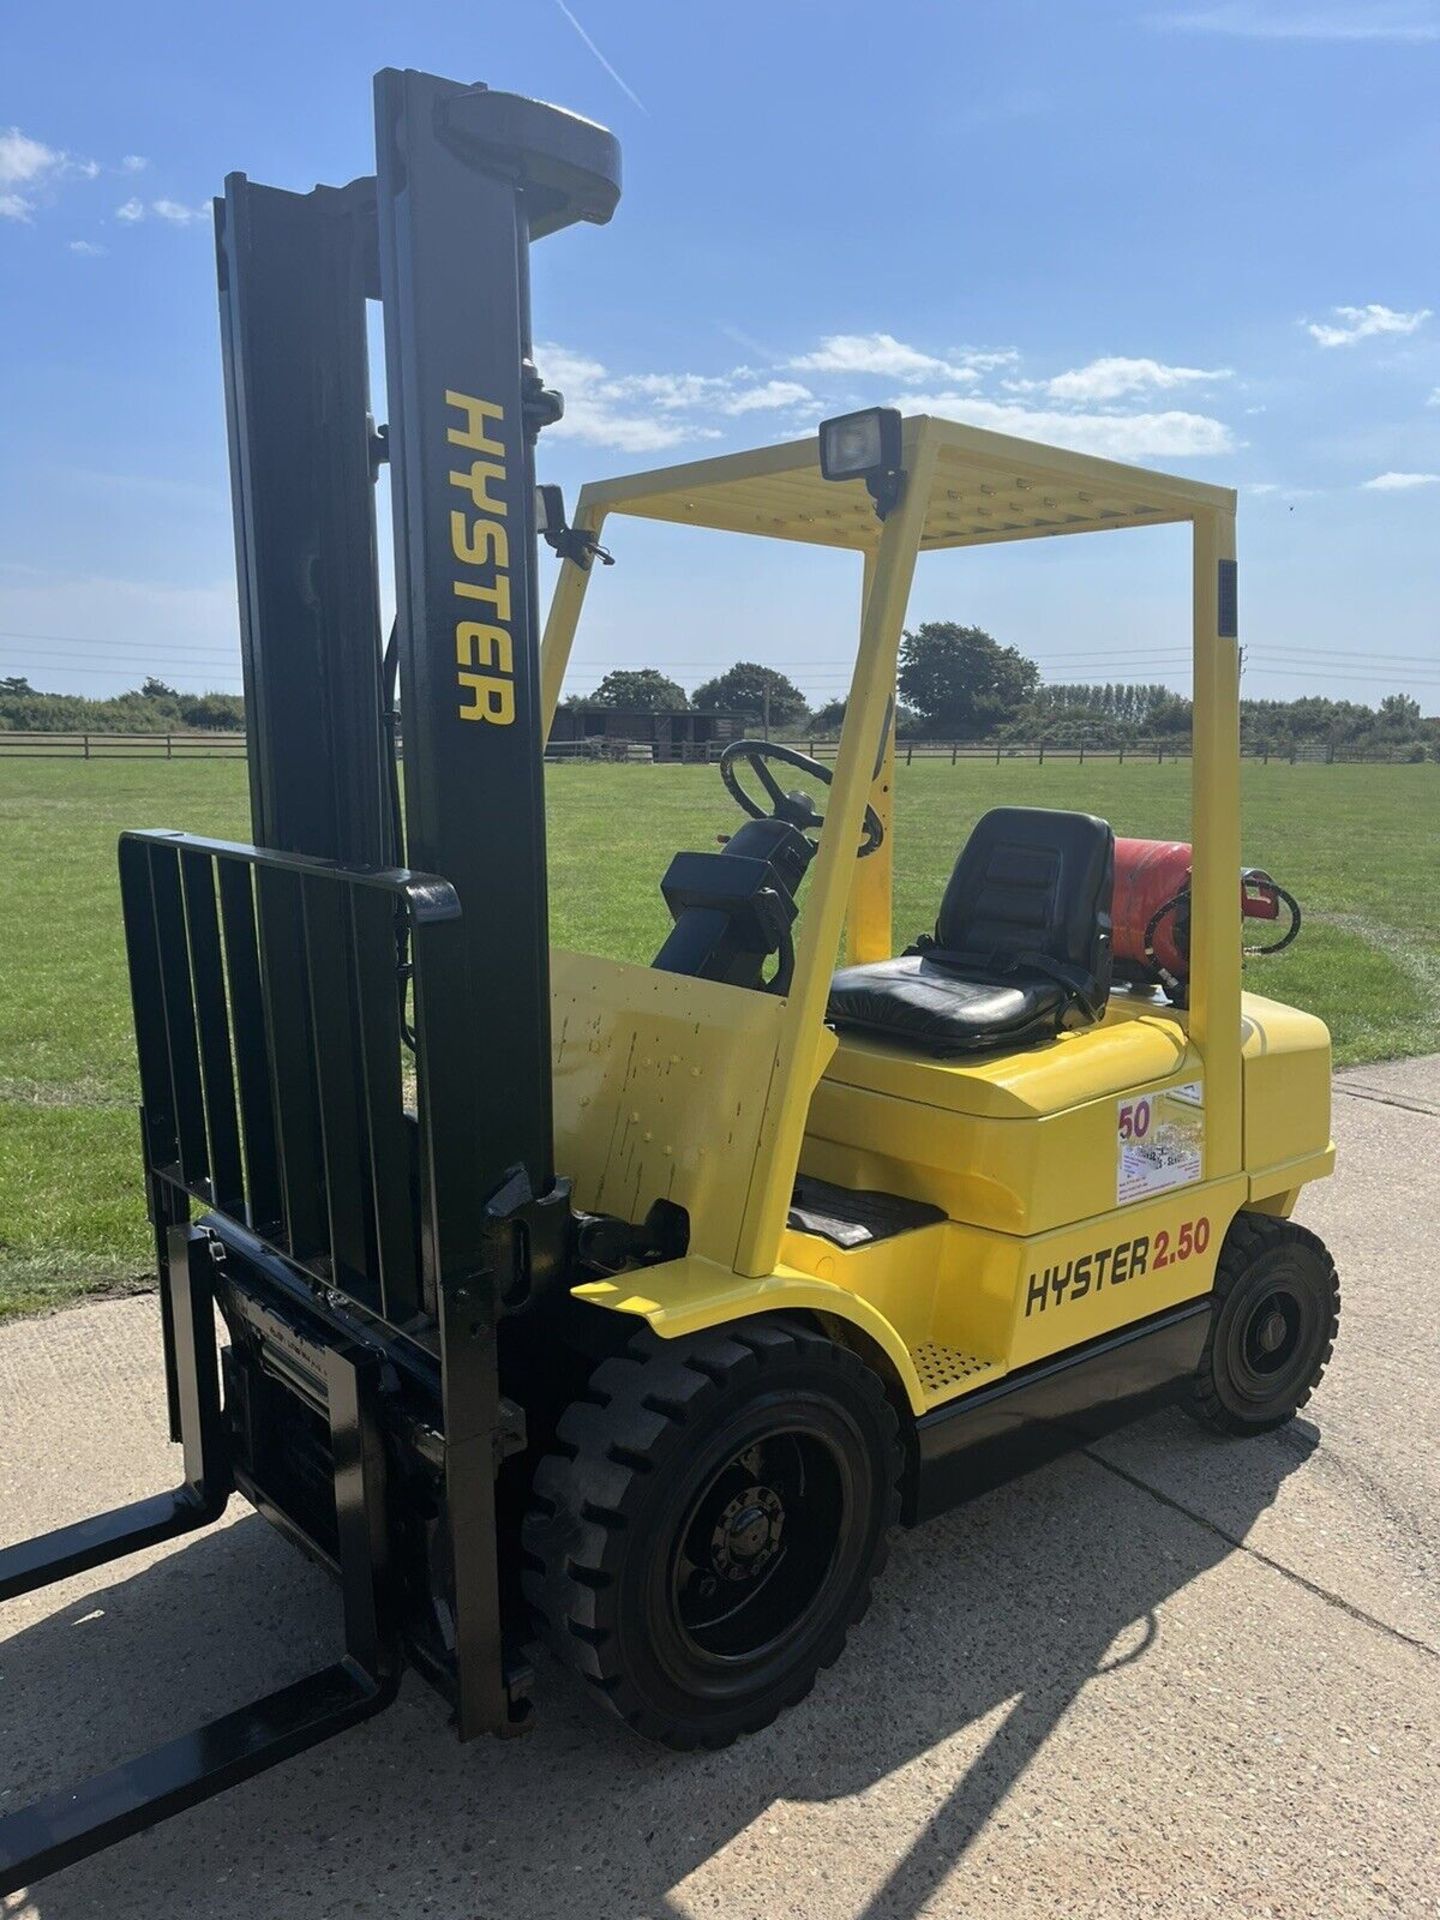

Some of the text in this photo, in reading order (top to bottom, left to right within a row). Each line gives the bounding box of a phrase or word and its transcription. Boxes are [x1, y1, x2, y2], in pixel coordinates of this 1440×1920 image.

[444, 389, 516, 727] HYSTER
[1118, 1100, 1150, 1139] 50
[1025, 1216, 1210, 1317] HYSTER 2.50
